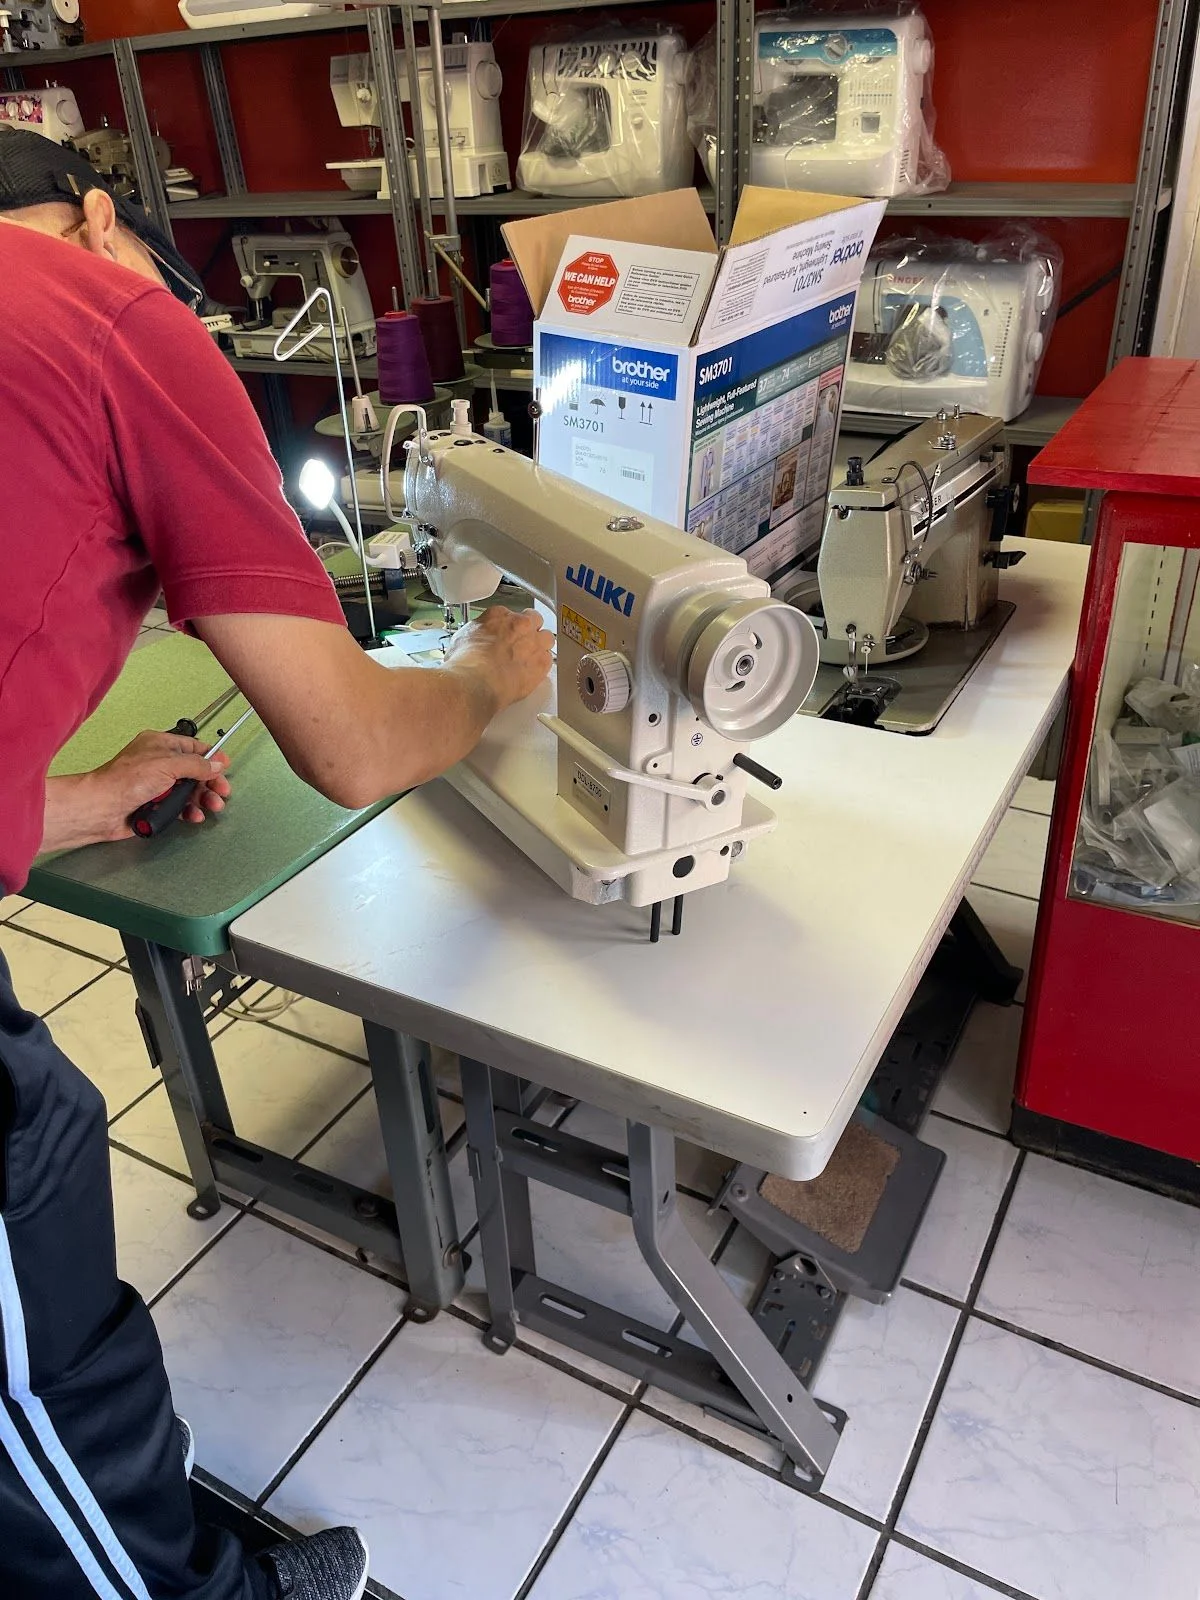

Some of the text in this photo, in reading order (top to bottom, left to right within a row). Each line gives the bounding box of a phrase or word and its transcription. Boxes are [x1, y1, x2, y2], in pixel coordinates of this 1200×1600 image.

[792, 244, 814, 260] Machine
[815, 240, 832, 252] Sewing
[830, 240, 864, 266] brother
[565, 271, 578, 282] WE
[577, 273, 594, 285] CAN
[594, 276, 616, 288] HELP
[762, 265, 798, 288] Full-Featured
[793, 268, 824, 293] SM3701
[567, 294, 596, 306] brother
[829, 303, 852, 324] brother
[612, 356, 670, 382] brother
[699, 356, 733, 386] SM3701
[621, 376, 659, 390] at your side
[758, 377, 768, 393] 37
[696, 395, 727, 417] Lightweight,
[727, 378, 758, 402] Full-Featured
[563, 415, 605, 433] SM3701
[695, 413, 714, 429] Sewing
[714, 403, 735, 419] Machine
[565, 563, 635, 618] JUKI
